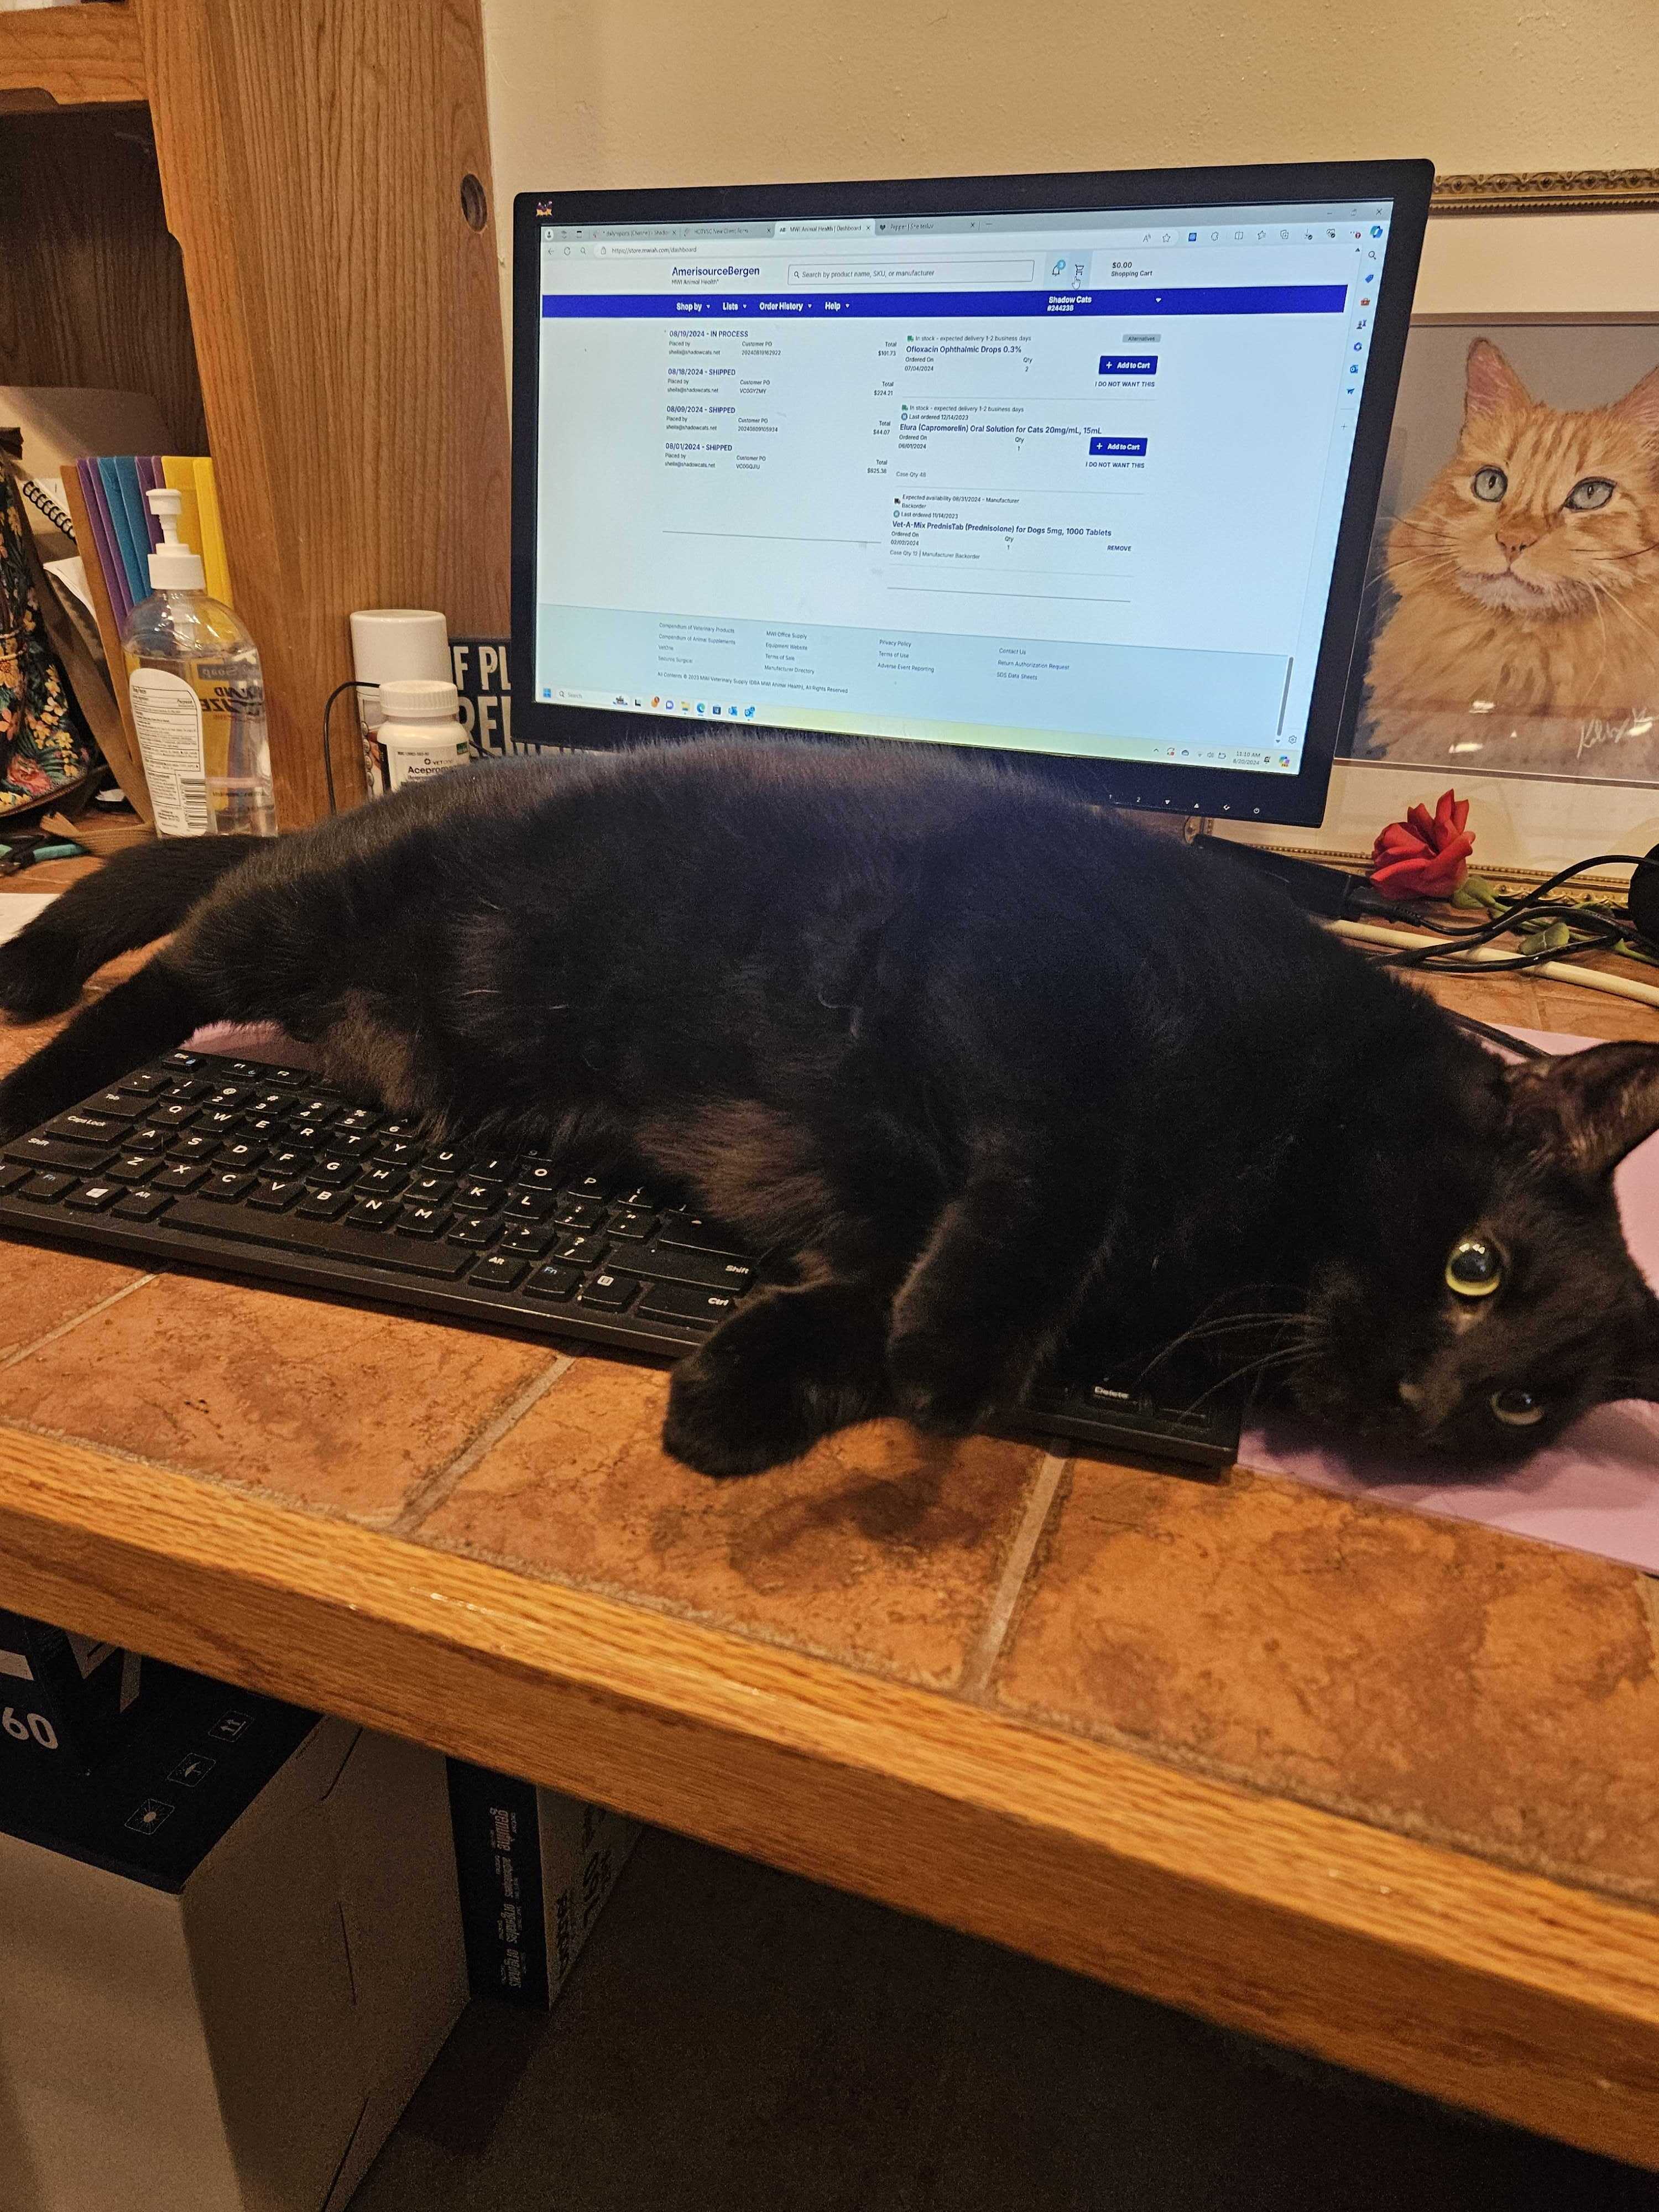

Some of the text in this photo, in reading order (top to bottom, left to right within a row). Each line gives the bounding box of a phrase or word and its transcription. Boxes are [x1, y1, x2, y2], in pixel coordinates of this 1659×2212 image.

[672, 267, 760, 277] AmerisourceBergen
[677, 302, 702, 311] Shop by
[779, 302, 803, 311] History
[825, 302, 841, 311] Help
[940, 346, 979, 354] Ophthalmic
[981, 346, 1001, 354] Drops
[919, 424, 968, 432] (Capromorelin)
[1045, 427, 1081, 435] 20mg/mL,
[966, 523, 1014, 533] (Prednisolone)
[440, 1151, 453, 1160] U
[127, 1157, 144, 1165] Z
[173, 1165, 190, 1174] X
[326, 1162, 340, 1170] G
[535, 1168, 547, 1177] O
[222, 1174, 237, 1182] C
[272, 1182, 285, 1192] V
[470, 1187, 487, 1196] K
[521, 1196, 530, 1206] L
[726, 1265, 749, 1274] Shift
[708, 1297, 729, 1306] Ctrl
[2, 1707, 58, 1749] 60
